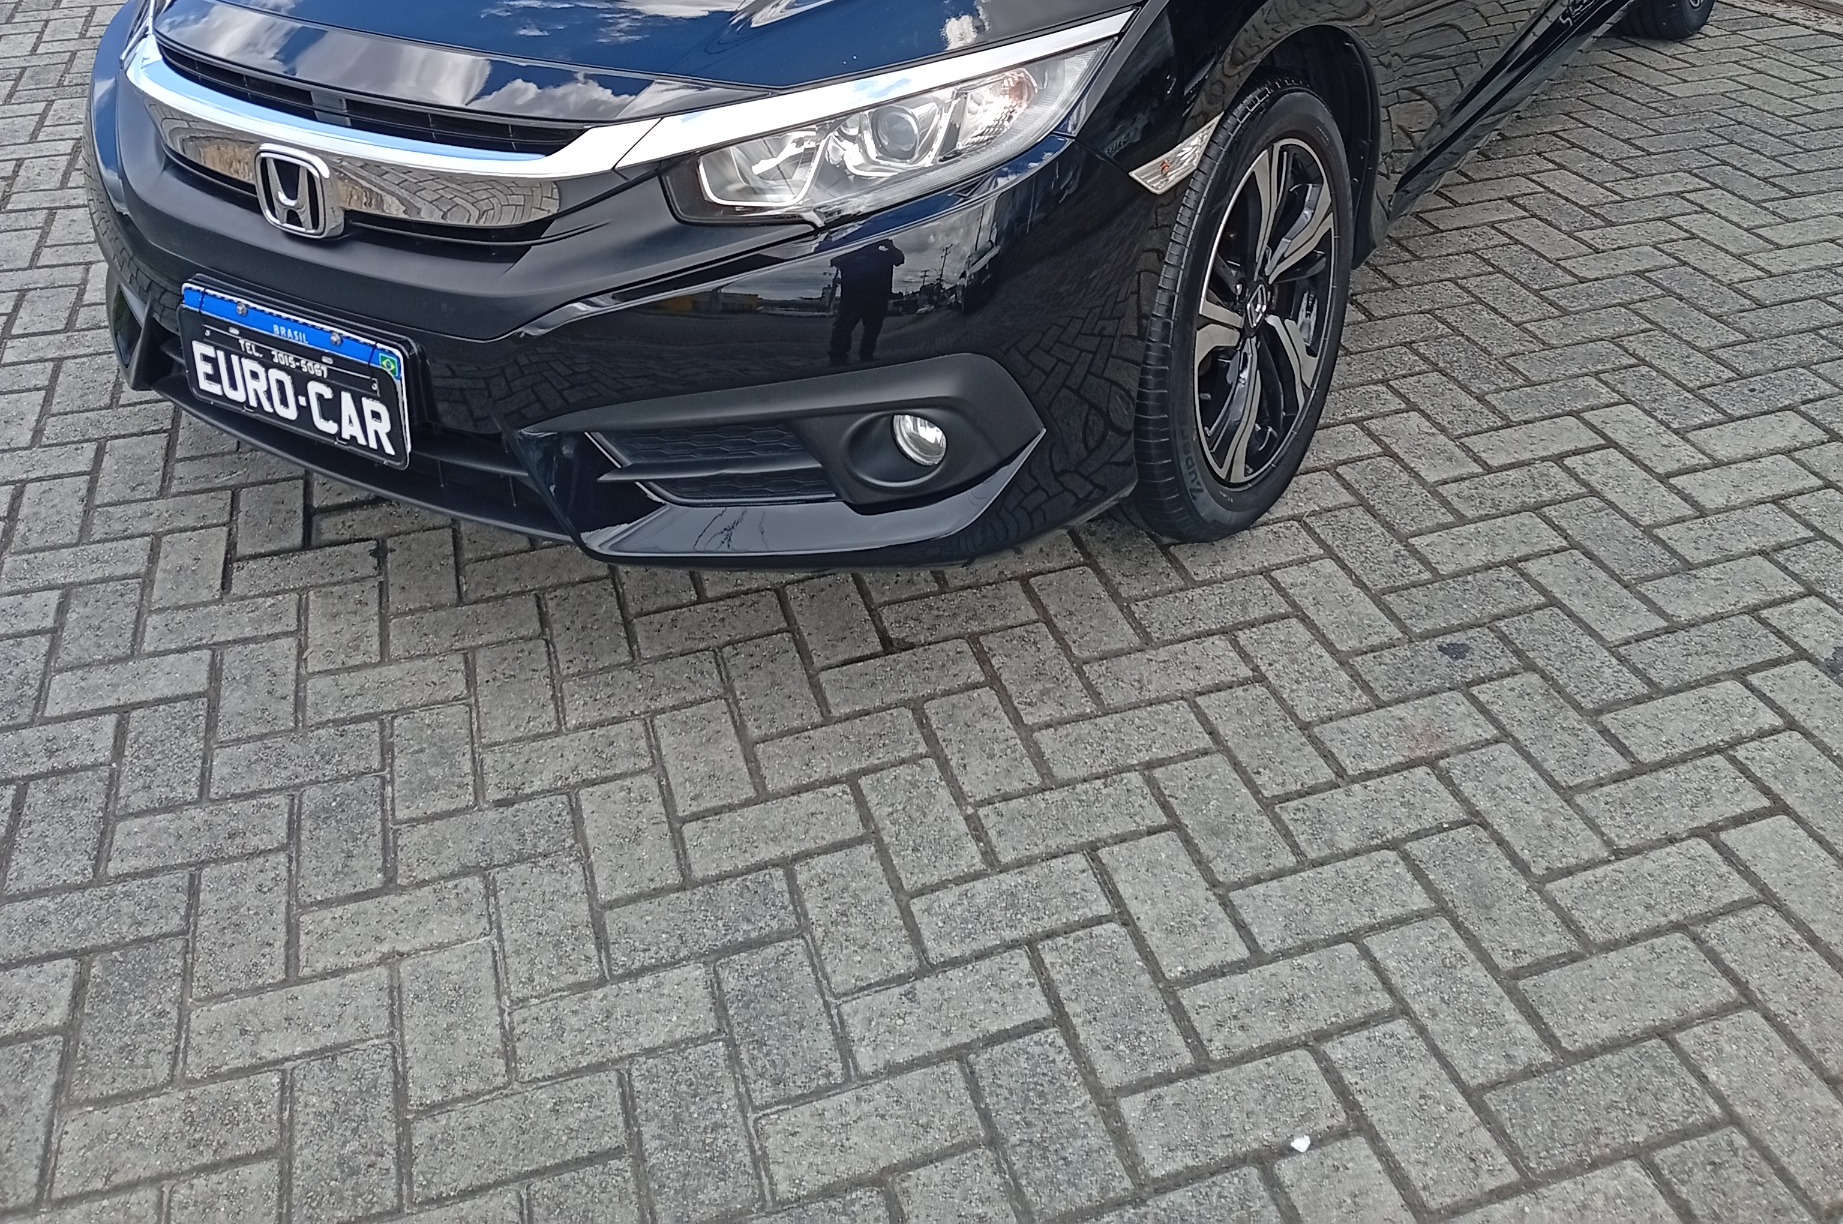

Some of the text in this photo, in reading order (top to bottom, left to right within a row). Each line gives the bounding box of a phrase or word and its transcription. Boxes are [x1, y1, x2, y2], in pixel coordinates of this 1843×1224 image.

[272, 324, 309, 344] BRASIL
[238, 339, 263, 358] TEL.
[191, 340, 396, 456] EURO-CAR
